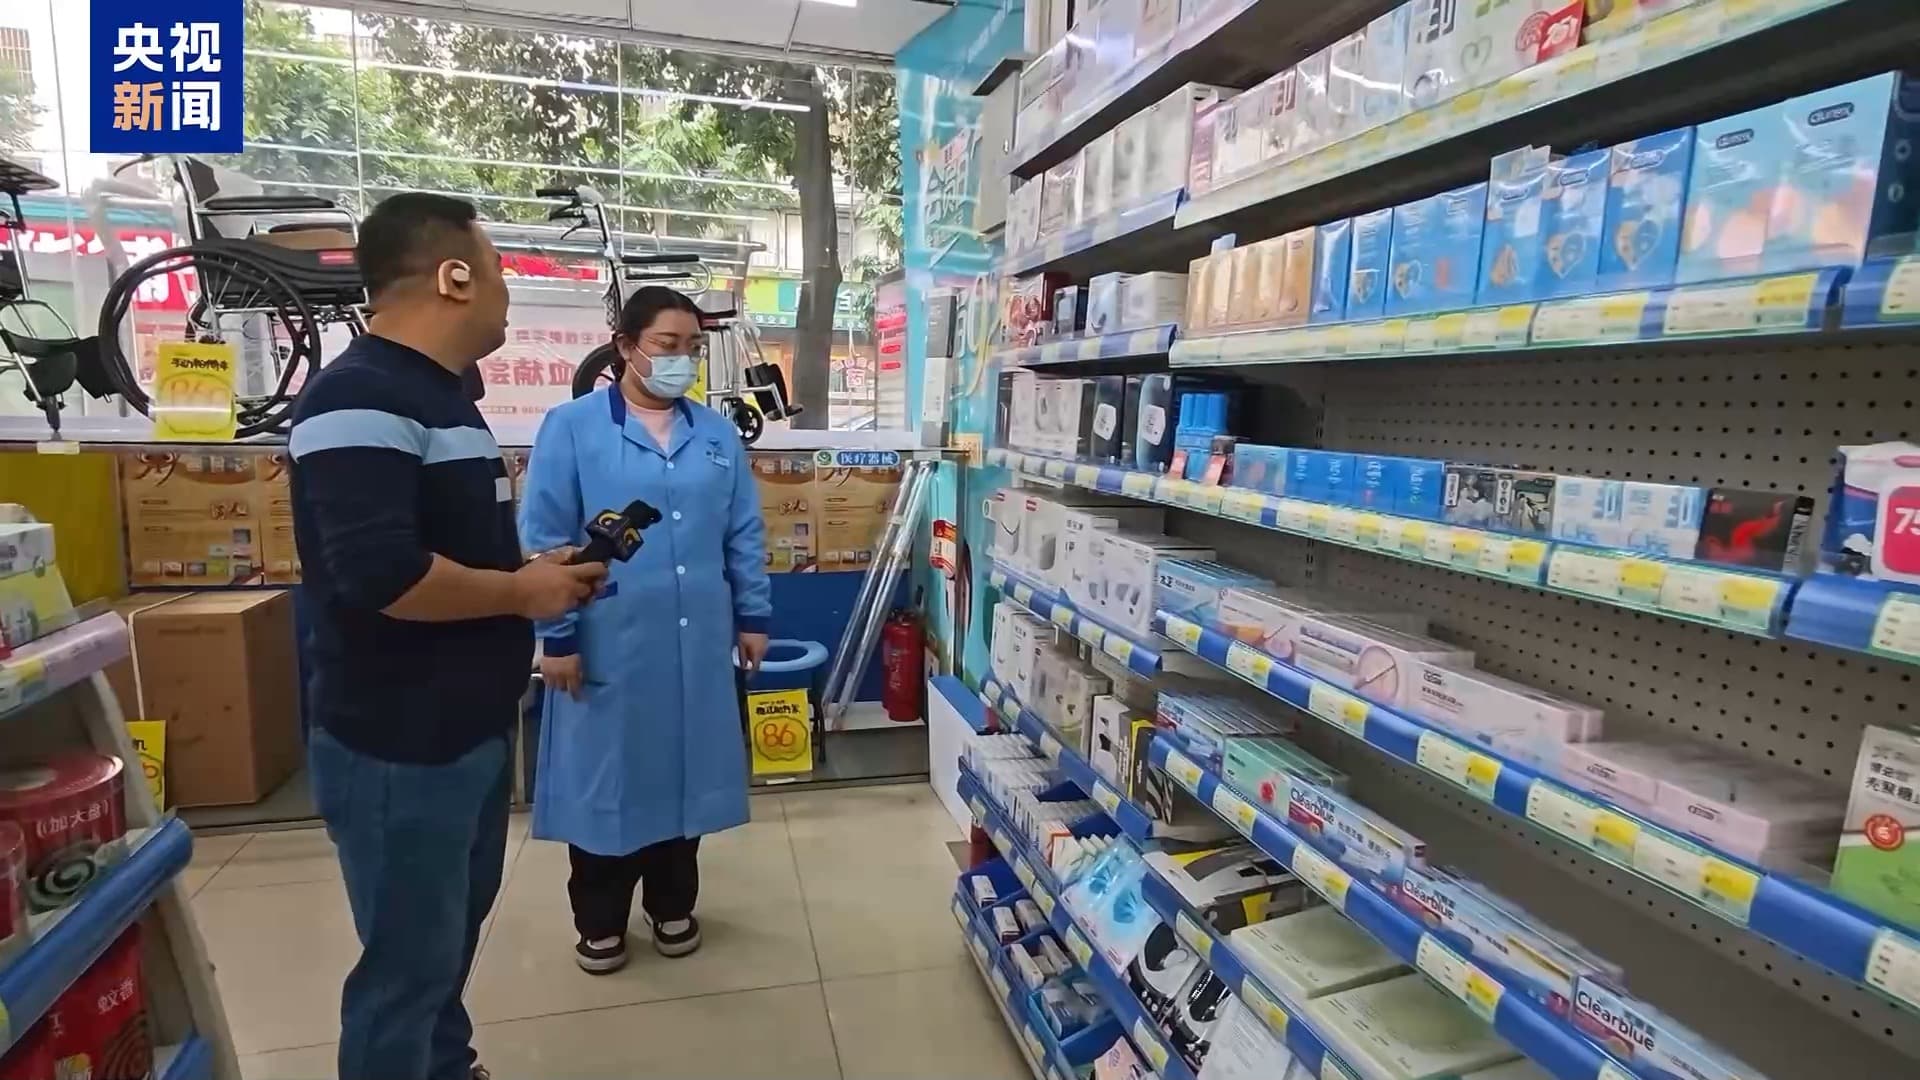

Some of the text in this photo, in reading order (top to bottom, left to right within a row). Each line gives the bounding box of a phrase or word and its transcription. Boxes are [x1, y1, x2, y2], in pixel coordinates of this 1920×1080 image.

[840, 451, 894, 465] 医疗器械
[762, 722, 797, 748] 86
[1404, 878, 1456, 921] Clearblue
[1577, 990, 1655, 1051] Clearblue
